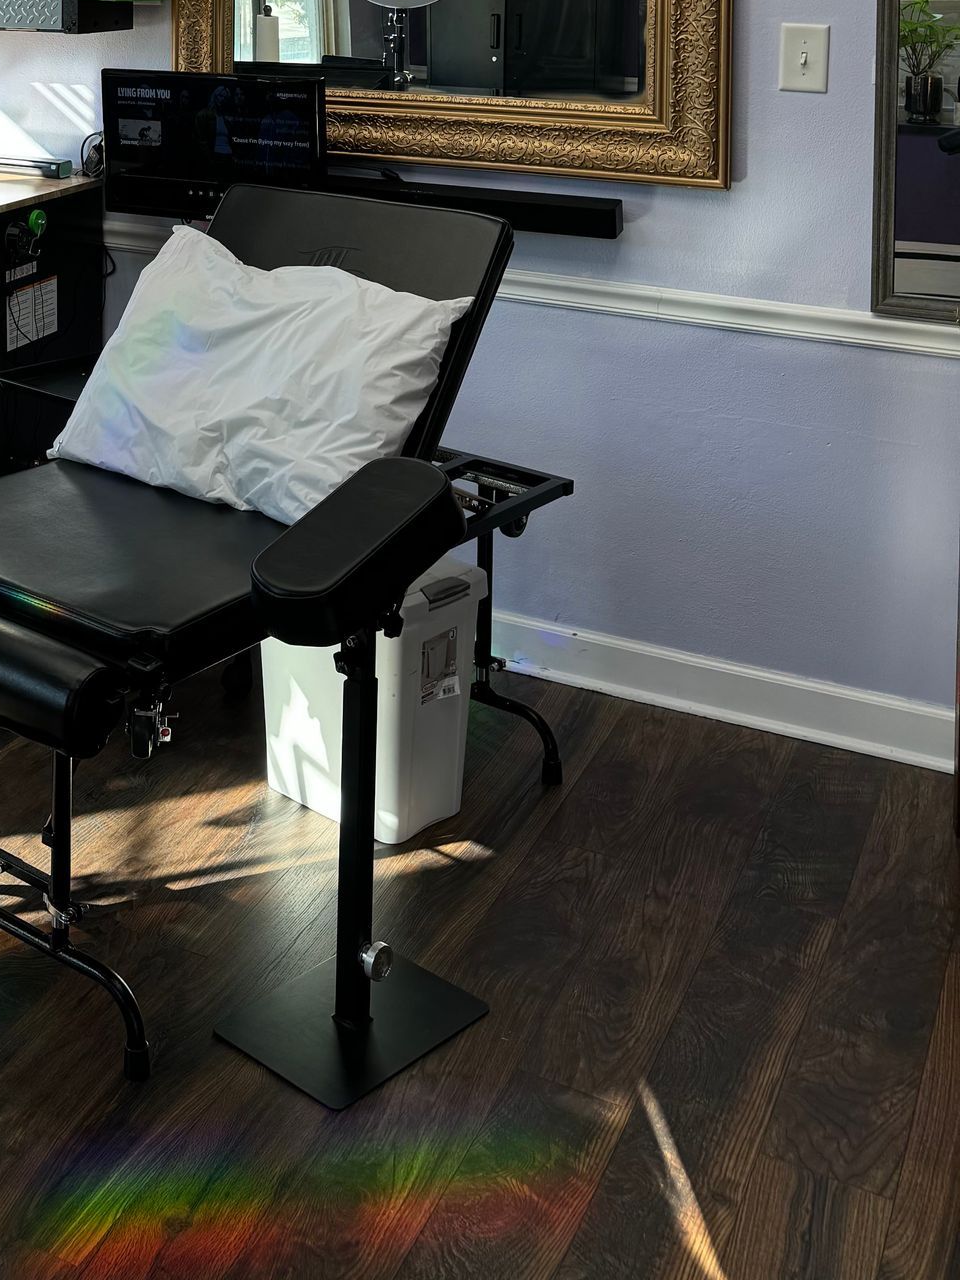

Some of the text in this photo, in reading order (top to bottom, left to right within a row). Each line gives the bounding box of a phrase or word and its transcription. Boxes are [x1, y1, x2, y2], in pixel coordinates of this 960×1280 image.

[117, 87, 171, 99] LYING FROM YOU
